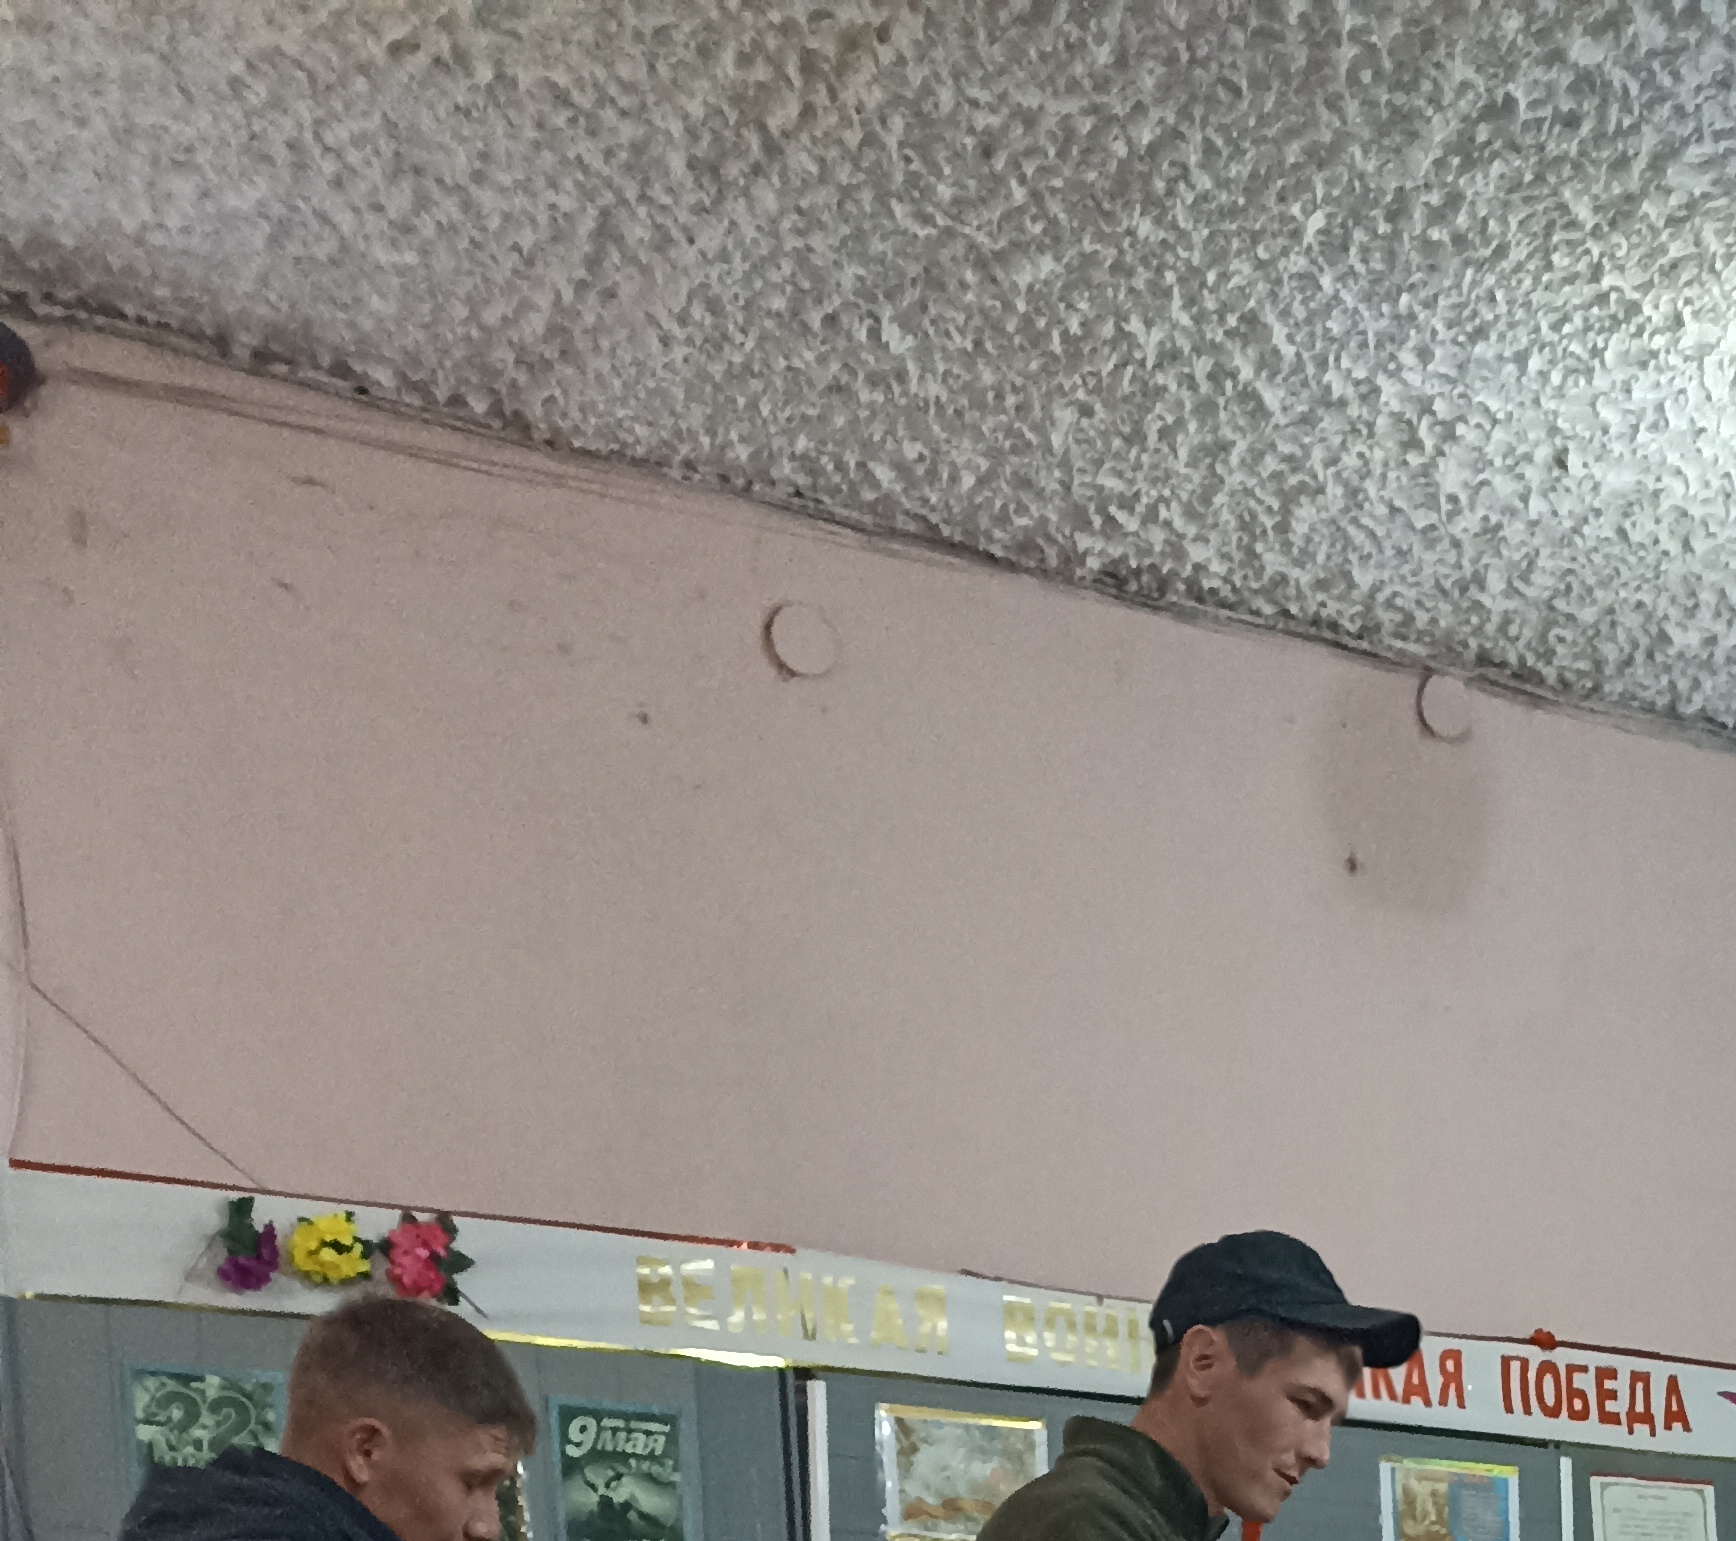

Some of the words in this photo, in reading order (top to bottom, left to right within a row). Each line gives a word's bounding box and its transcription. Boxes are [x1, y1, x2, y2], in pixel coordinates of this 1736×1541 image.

[636, 1256, 949, 1355] ВЕЛИКАЯ
[1003, 1295, 1155, 1374] ВОЙН
[1355, 1347, 1466, 1409] КАЯ
[1500, 1354, 1693, 1437] ПОБЕДА
[565, 1415, 598, 1458] 9
